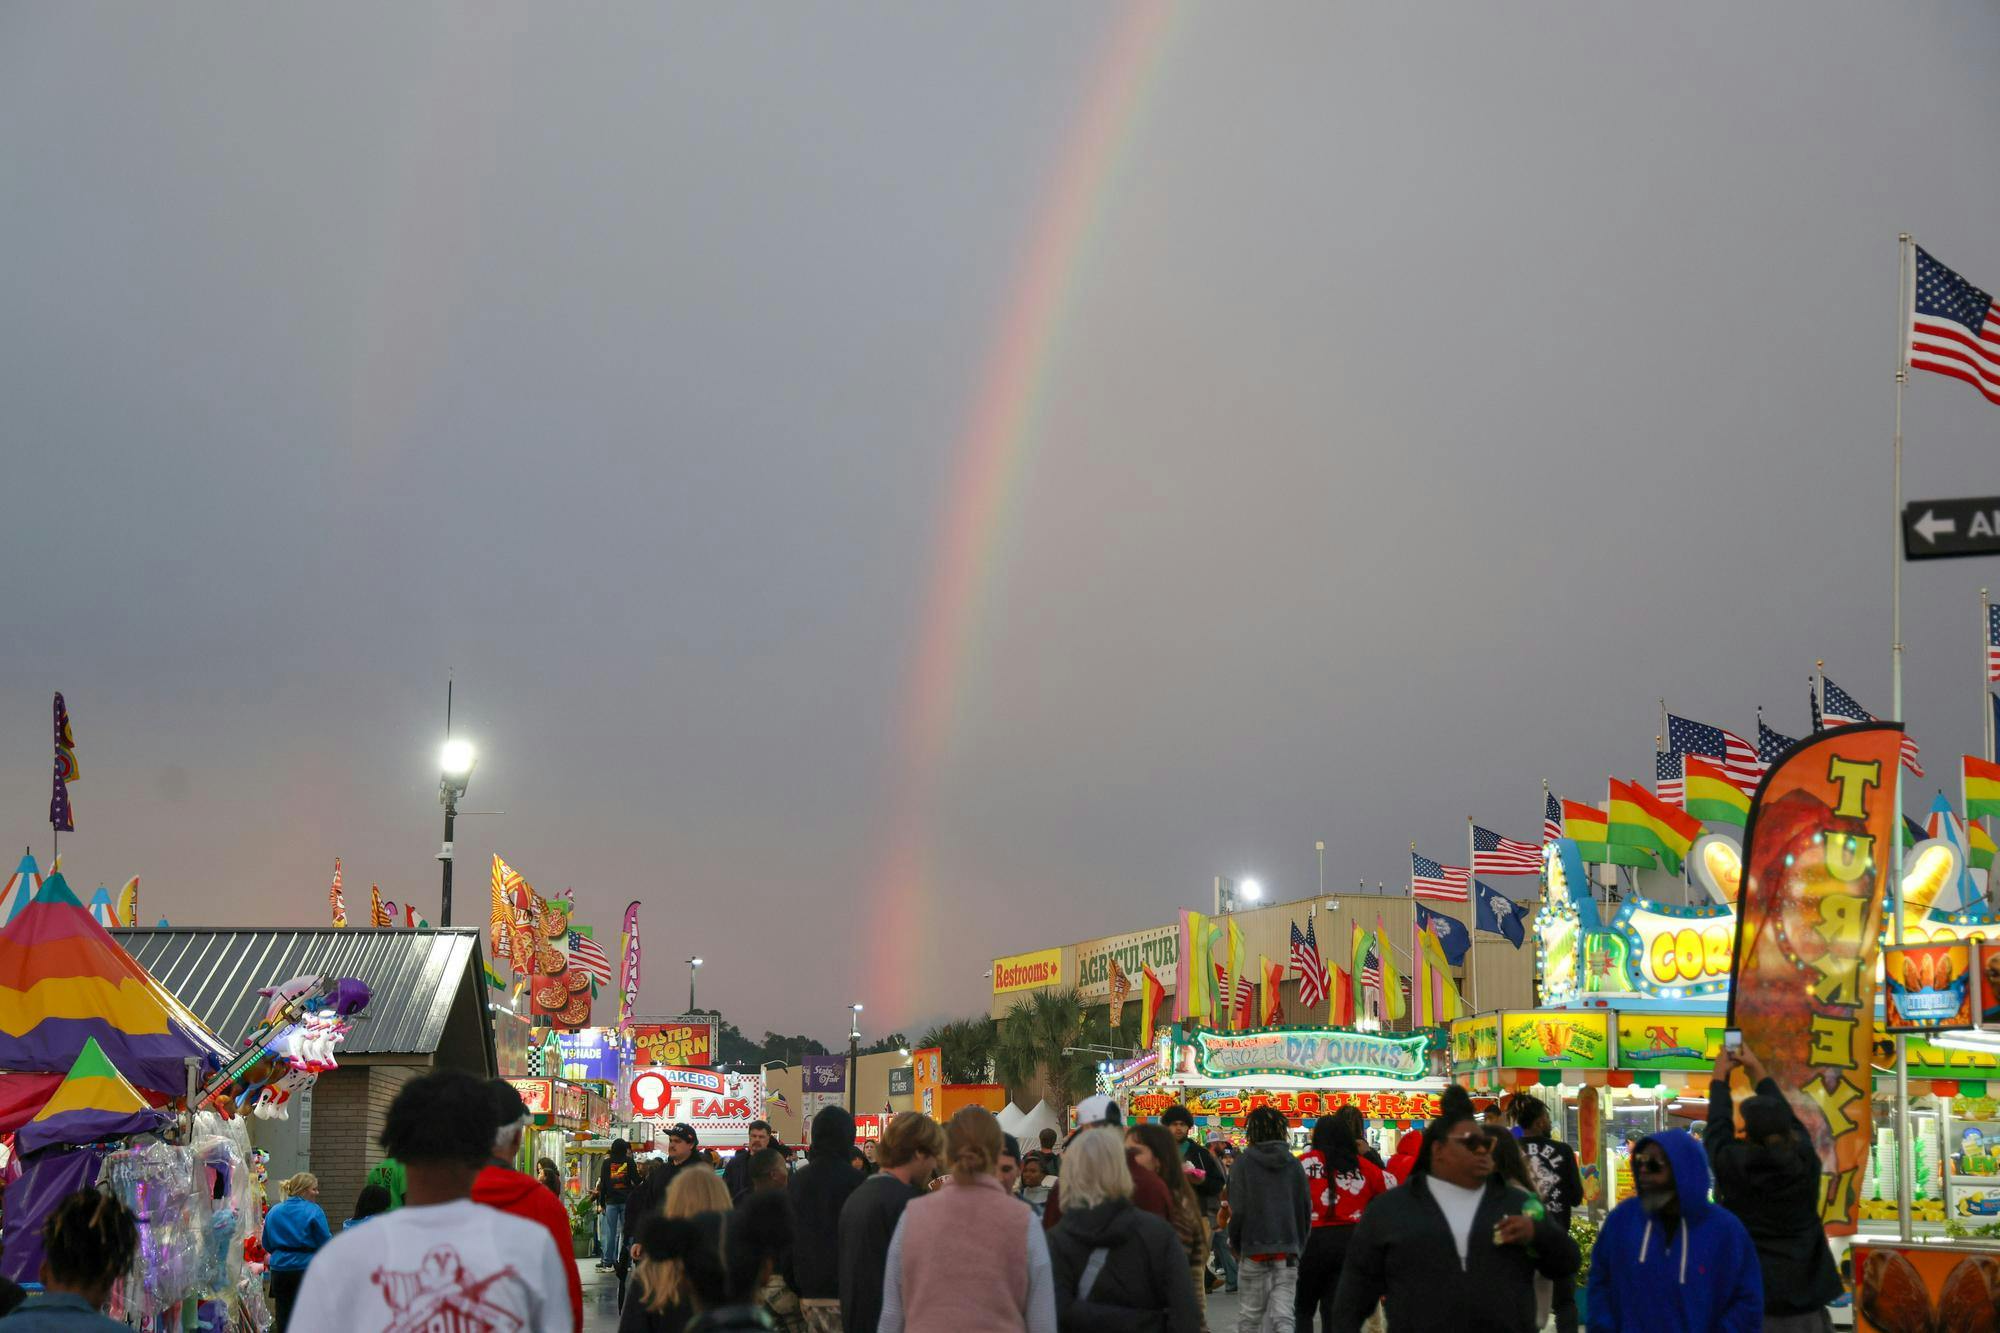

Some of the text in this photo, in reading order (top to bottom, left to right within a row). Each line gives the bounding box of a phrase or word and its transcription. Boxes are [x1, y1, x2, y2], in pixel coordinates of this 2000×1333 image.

[996, 961, 1049, 988] Restrooms
[635, 1026, 693, 1049] OASTED
[650, 1036, 708, 1061] CORN
[691, 1096, 752, 1119] EARS
